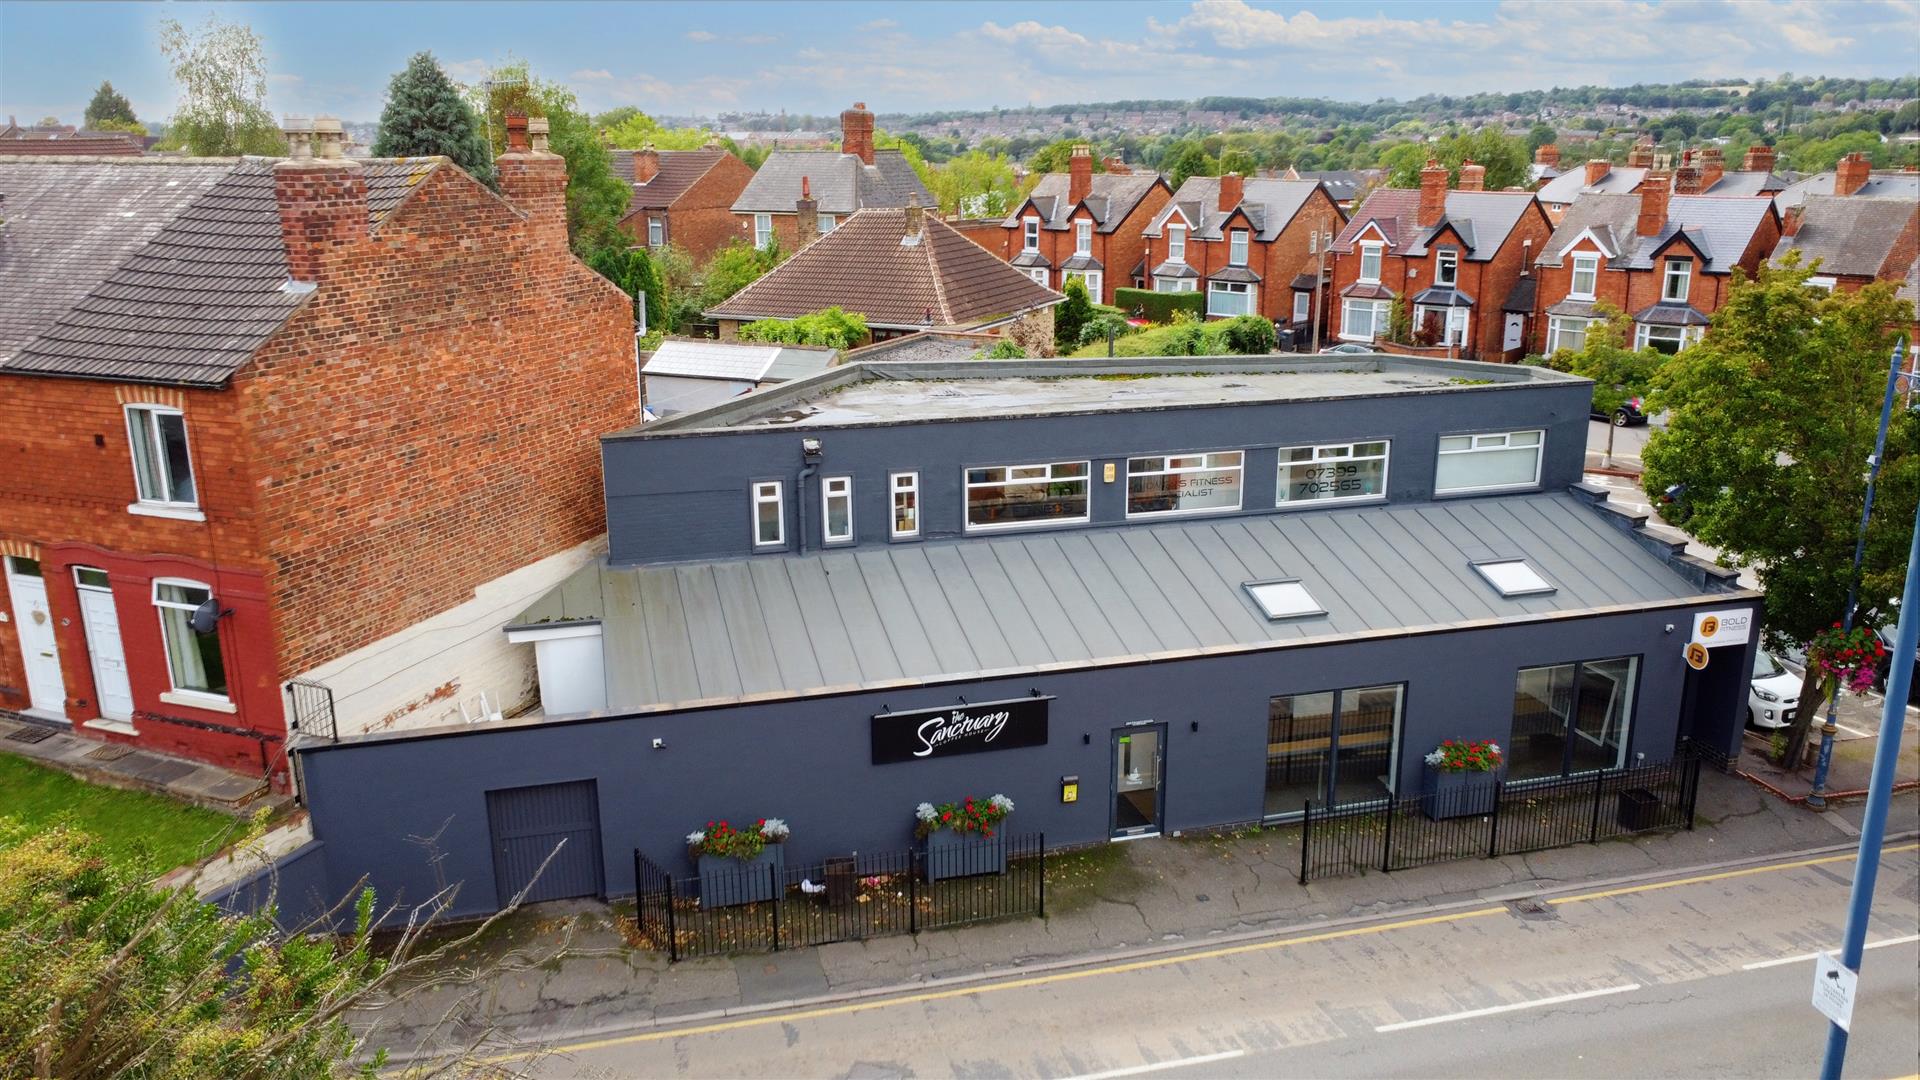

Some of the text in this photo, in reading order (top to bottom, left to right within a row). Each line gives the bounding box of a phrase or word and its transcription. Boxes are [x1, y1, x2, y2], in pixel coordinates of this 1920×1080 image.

[1306, 466, 1357, 479] 07399
[1190, 476, 1233, 488] FITNESS
[1300, 480, 1361, 494] 702565
[1721, 616, 1748, 626] BOLD
[913, 711, 1009, 757] Sanctuary
